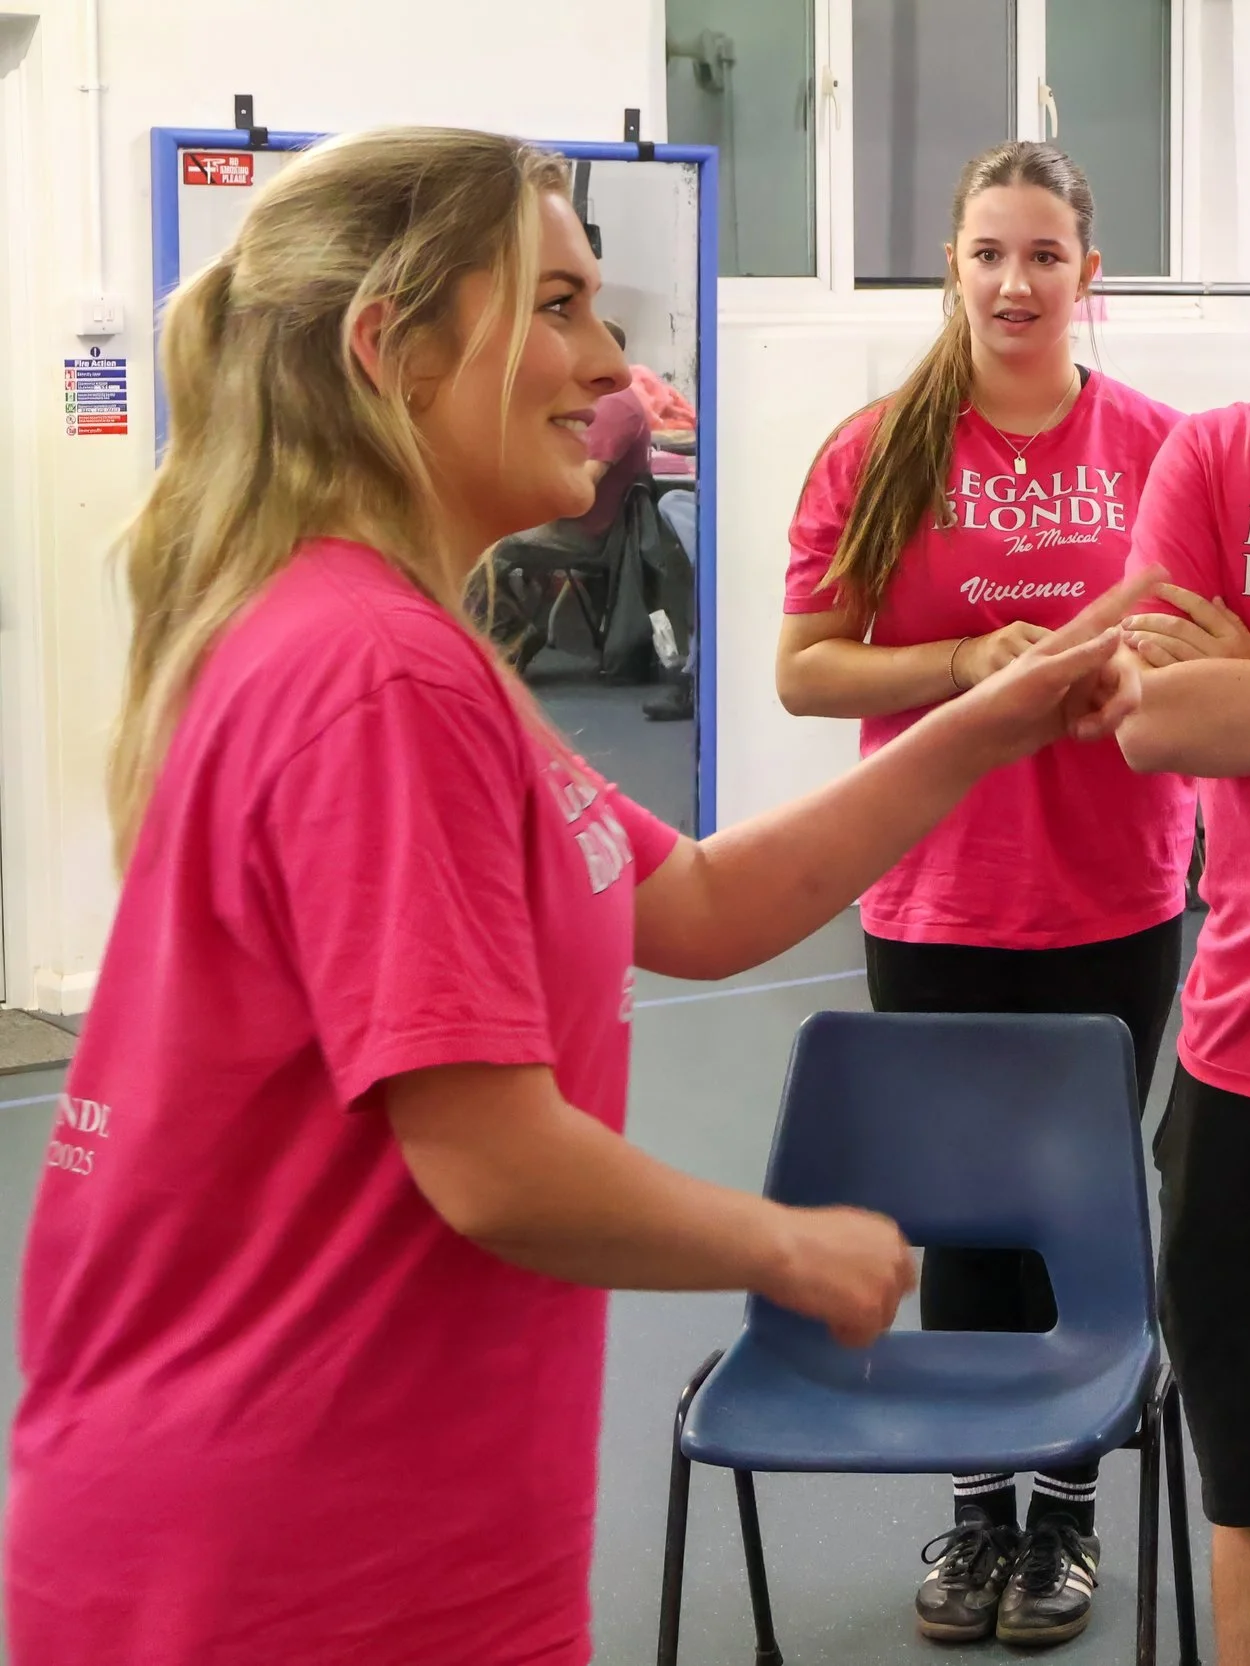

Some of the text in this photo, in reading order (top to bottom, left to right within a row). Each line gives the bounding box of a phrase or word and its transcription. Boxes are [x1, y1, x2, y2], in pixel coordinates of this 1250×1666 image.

[229, 157, 239, 166] NO
[91, 360, 117, 368] Action
[946, 464, 1124, 504] EGALLY
[1003, 526, 1102, 557] The Musical
[960, 576, 1086, 605] Vivienne
